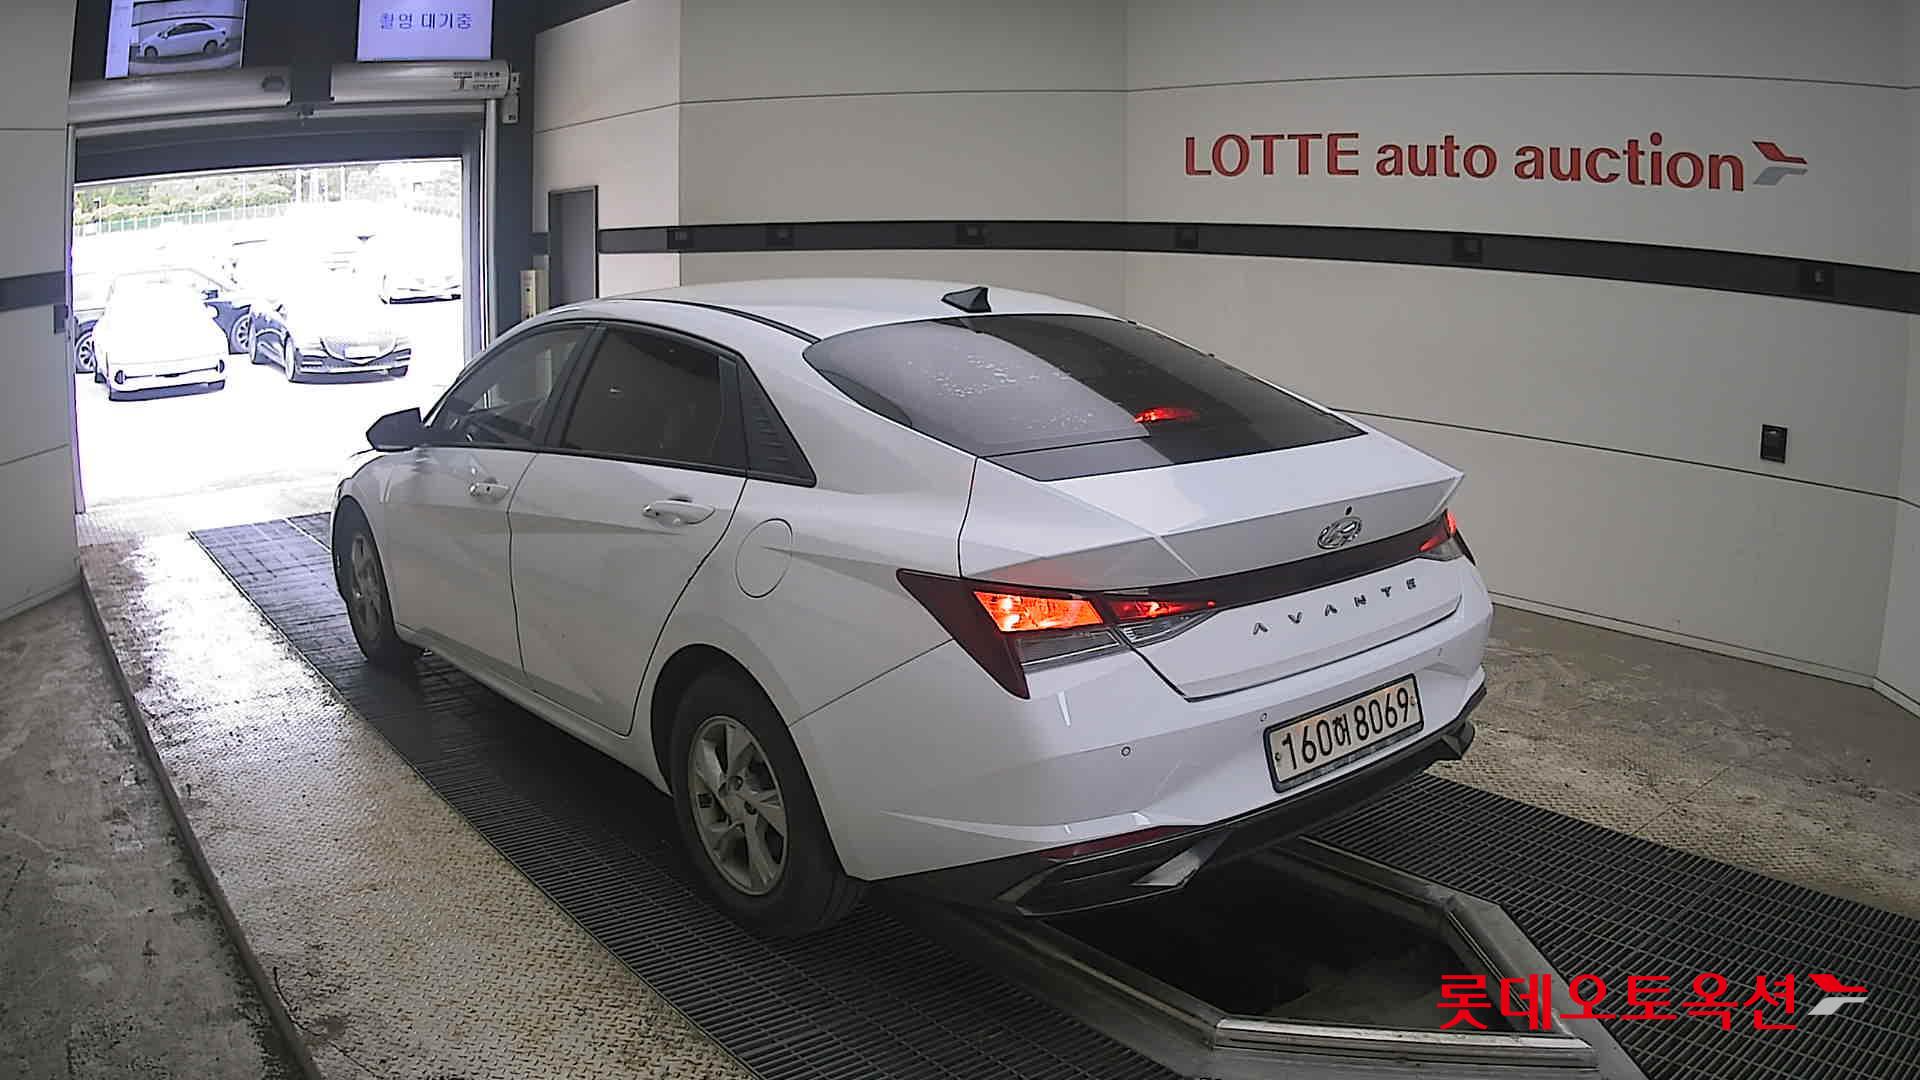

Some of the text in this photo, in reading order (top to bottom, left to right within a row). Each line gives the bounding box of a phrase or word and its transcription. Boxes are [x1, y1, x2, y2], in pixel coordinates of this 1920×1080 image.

[421, 12, 473, 30] 대기중
[1185, 132, 1745, 191] LOTTE auto auction
[1252, 577, 1417, 635] AVANTE
